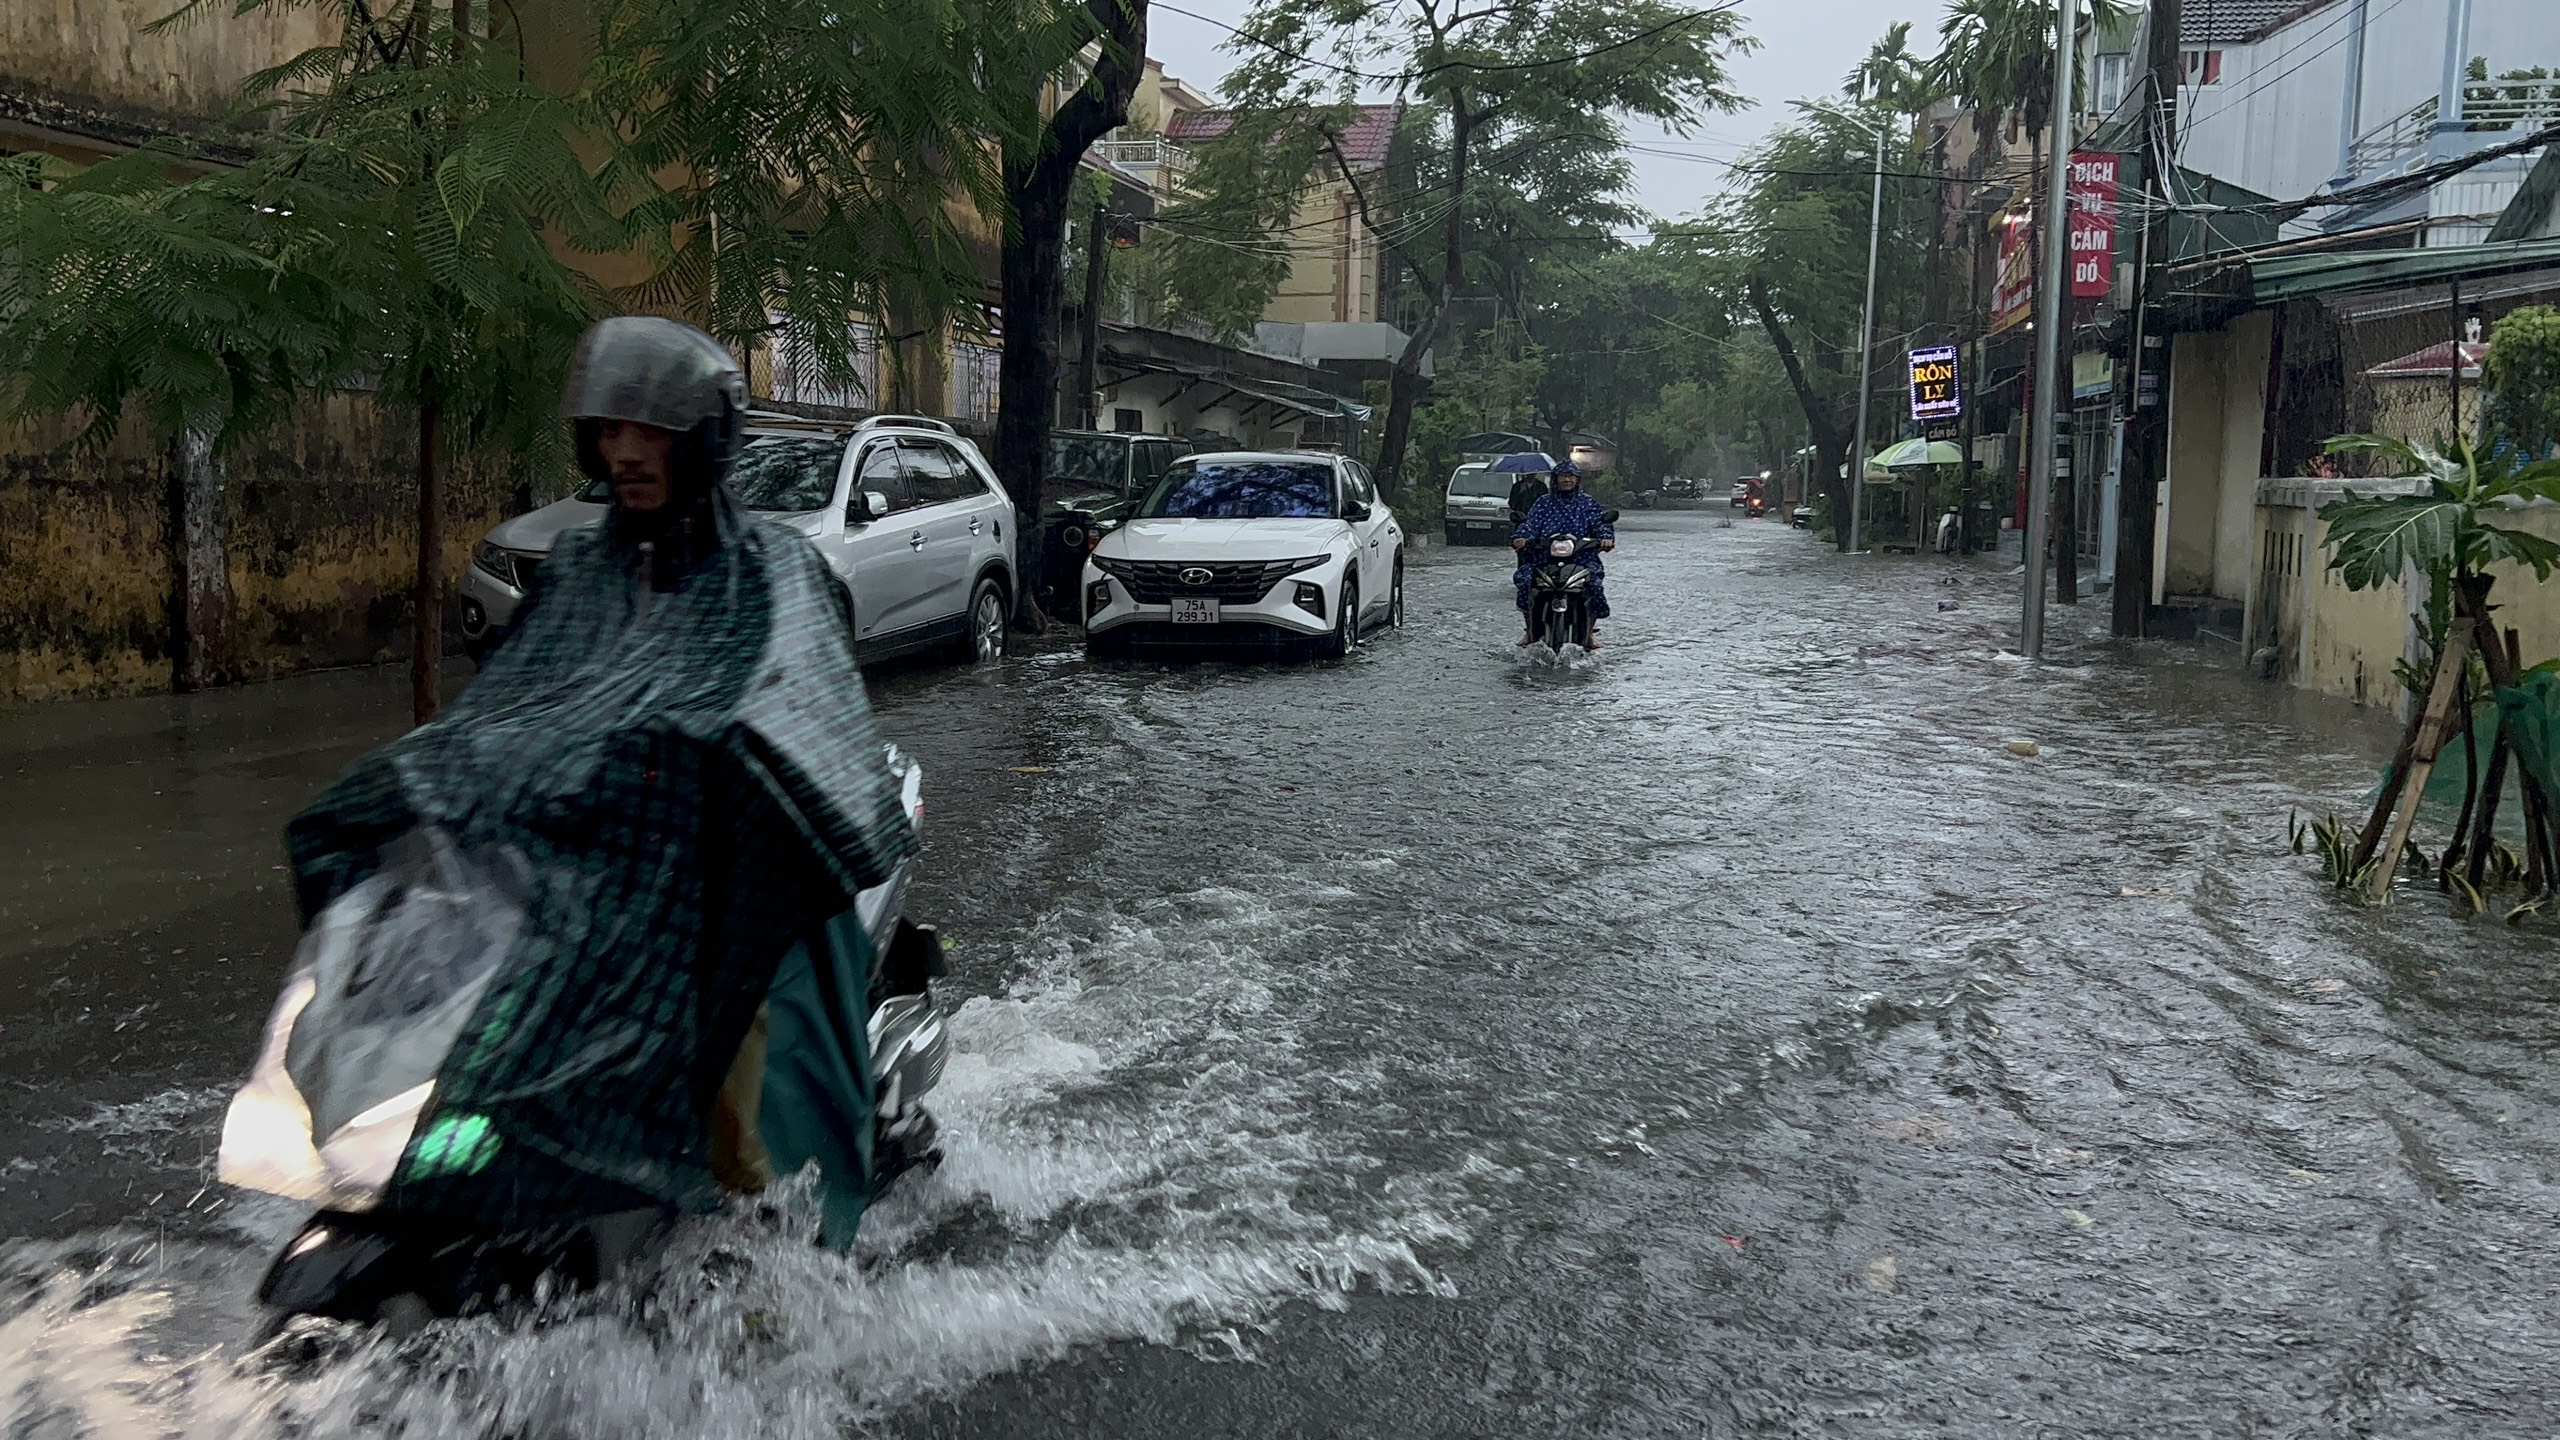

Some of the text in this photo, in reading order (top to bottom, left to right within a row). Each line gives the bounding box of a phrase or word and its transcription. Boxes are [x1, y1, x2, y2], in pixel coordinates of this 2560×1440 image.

[2075, 162, 2114, 186] DỊCH
[2071, 224, 2108, 250] CẦM
[2076, 256, 2098, 282] ĐỒ
[1914, 364, 1952, 383] RÔN
[1185, 600, 1205, 610] 75A
[1177, 612, 1213, 622] 299.31
